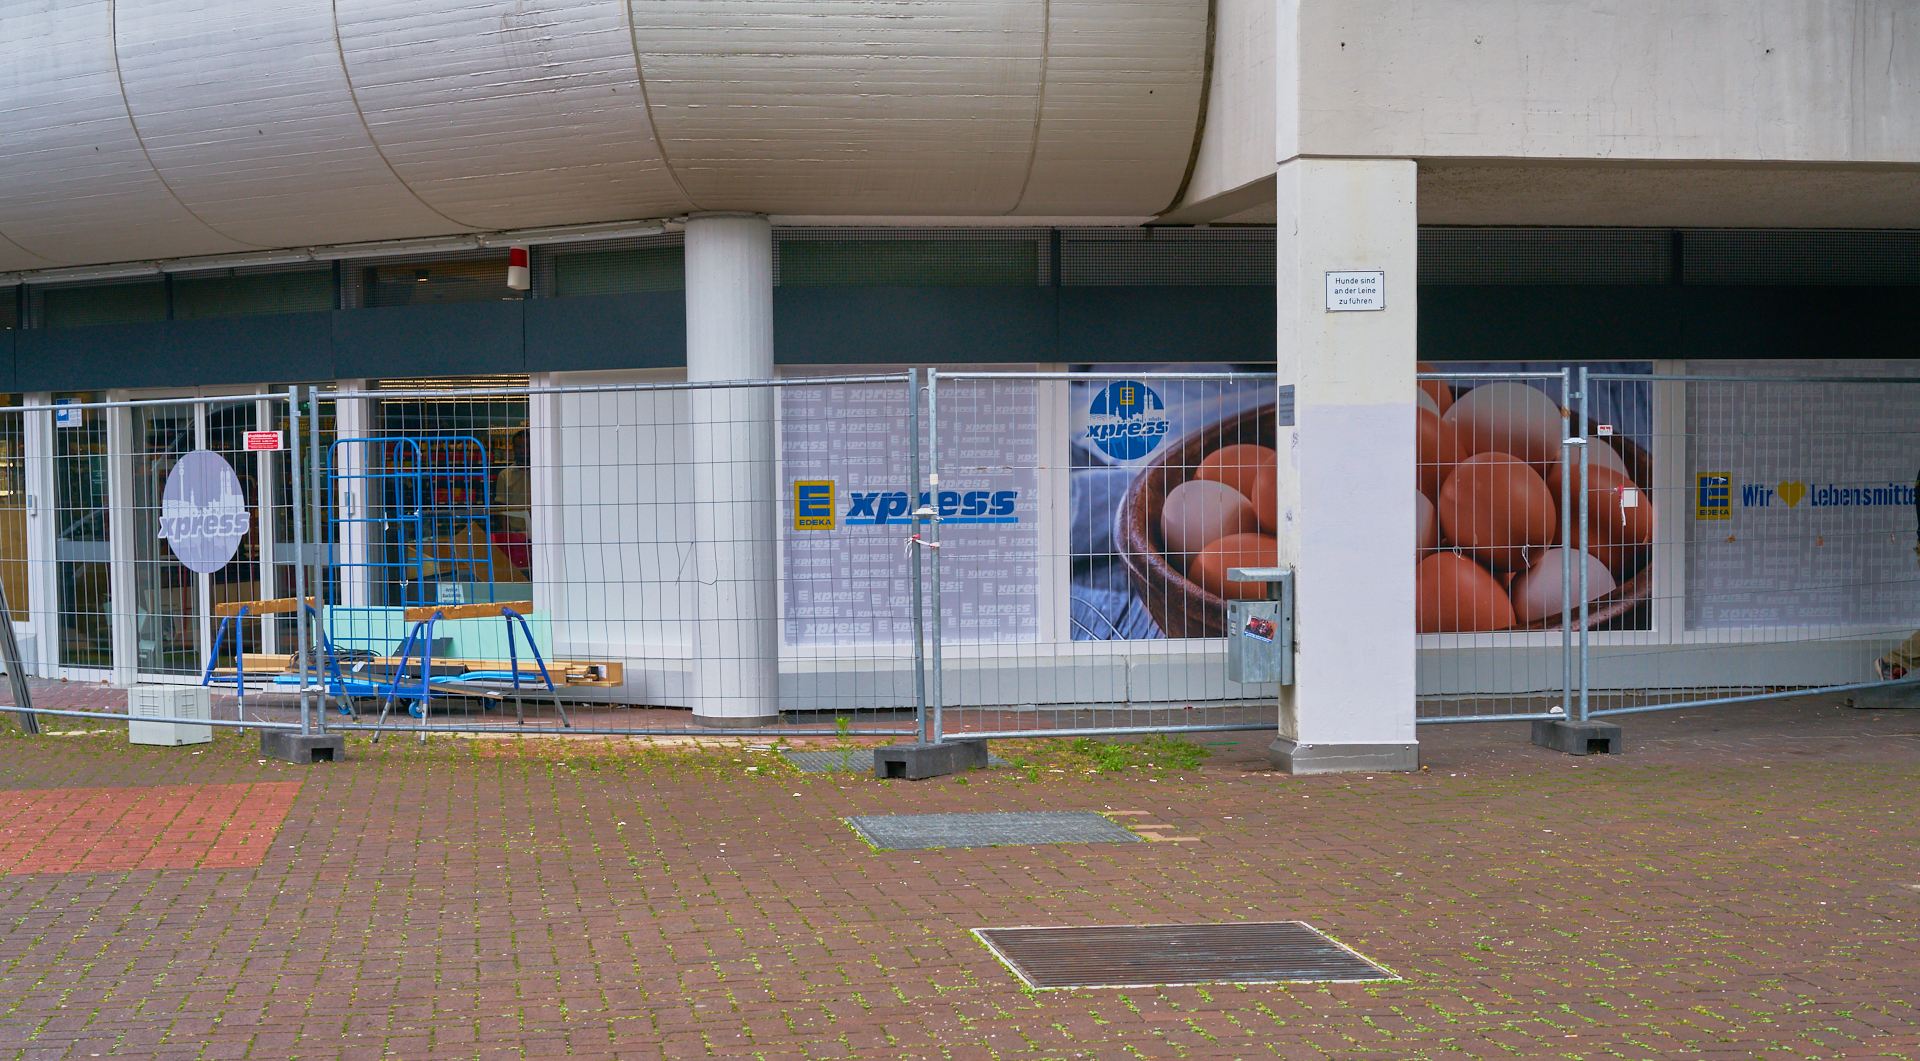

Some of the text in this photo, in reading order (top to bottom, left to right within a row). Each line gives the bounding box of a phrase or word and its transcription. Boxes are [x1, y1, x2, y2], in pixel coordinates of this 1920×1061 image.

[1086, 421, 1169, 439] xpress
[783, 441, 828, 452] press
[1743, 484, 1774, 508] Wir
[1811, 483, 1918, 507] Lebensmitte
[160, 514, 250, 540] xpress
